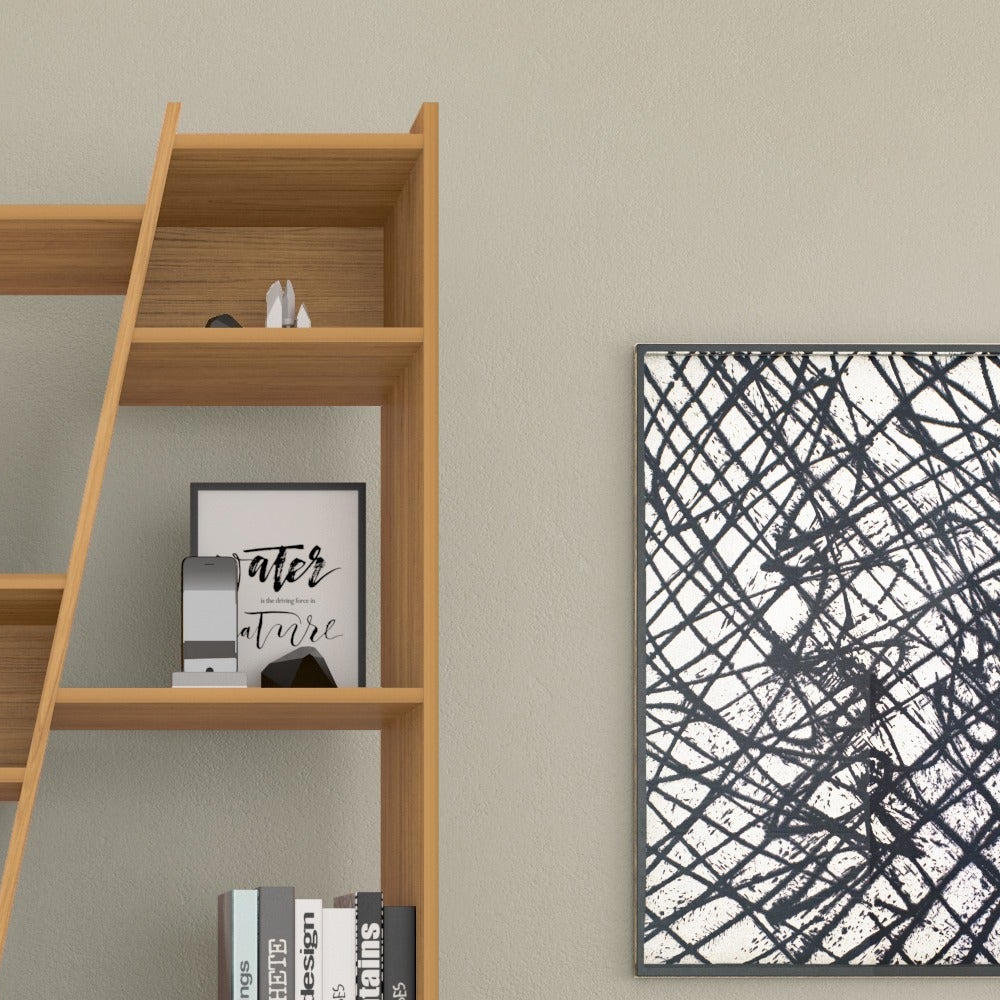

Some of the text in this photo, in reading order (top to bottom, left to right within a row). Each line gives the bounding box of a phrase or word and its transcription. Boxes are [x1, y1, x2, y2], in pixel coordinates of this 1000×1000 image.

[232, 544, 342, 593] ater
[275, 597, 295, 606] driving
[238, 610, 344, 650] ature
